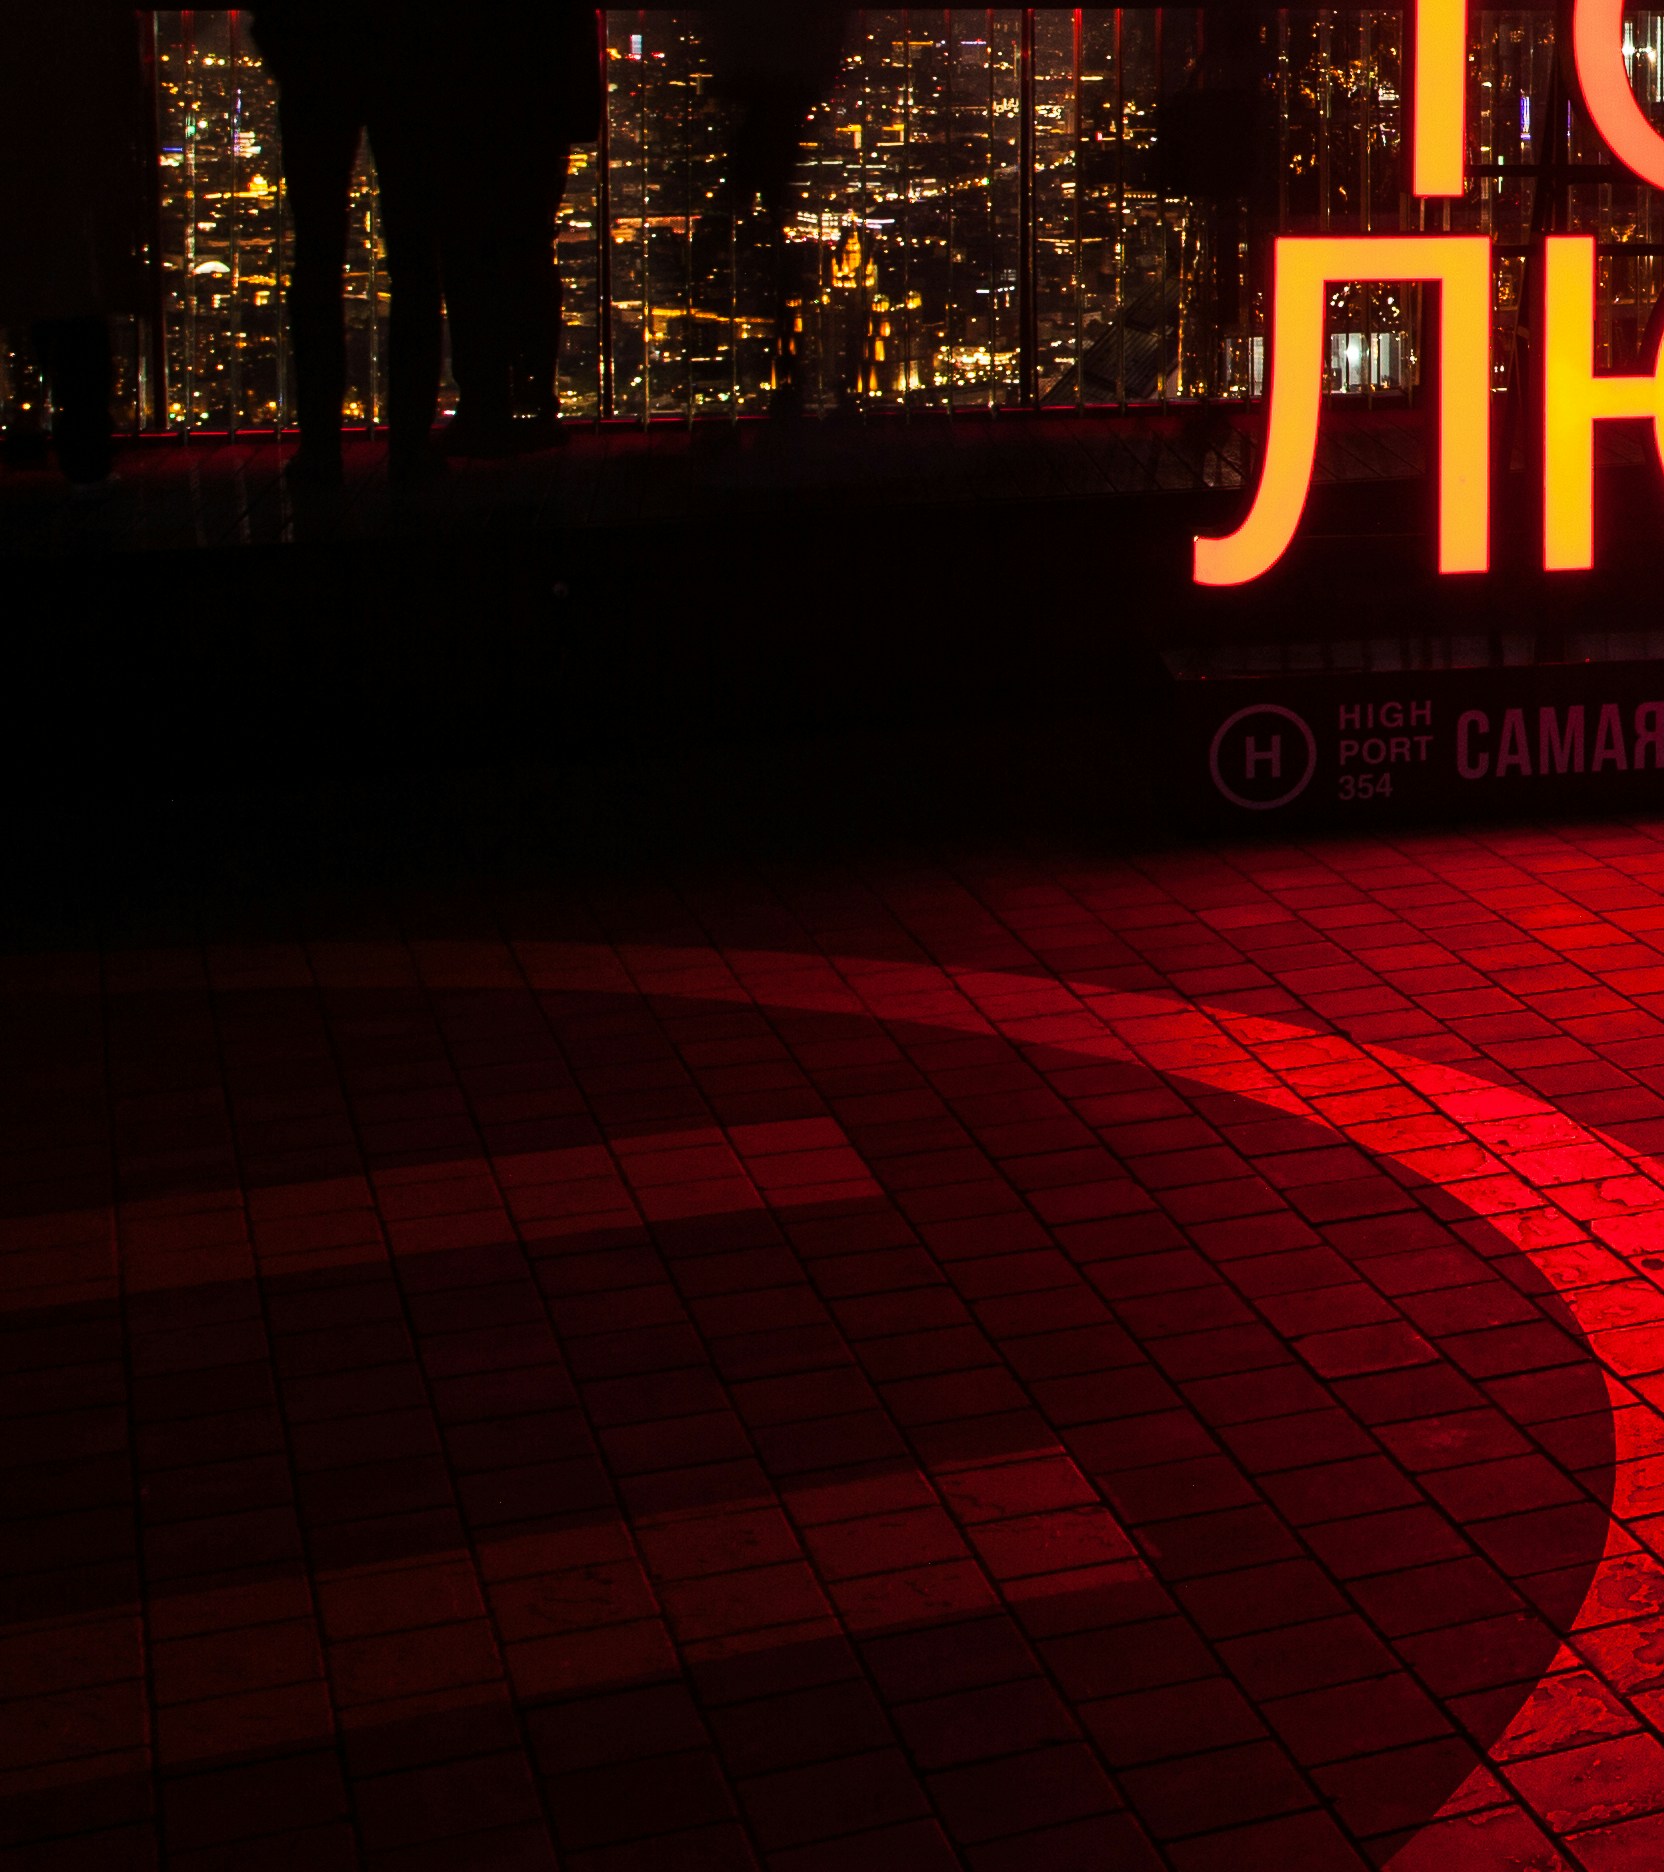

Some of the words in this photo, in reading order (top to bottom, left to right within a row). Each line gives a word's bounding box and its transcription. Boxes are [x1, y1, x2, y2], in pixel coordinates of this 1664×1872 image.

[1338, 700, 1433, 730] HIGH
[1338, 735, 1433, 766] PORT
[1338, 773, 1393, 801] 354
